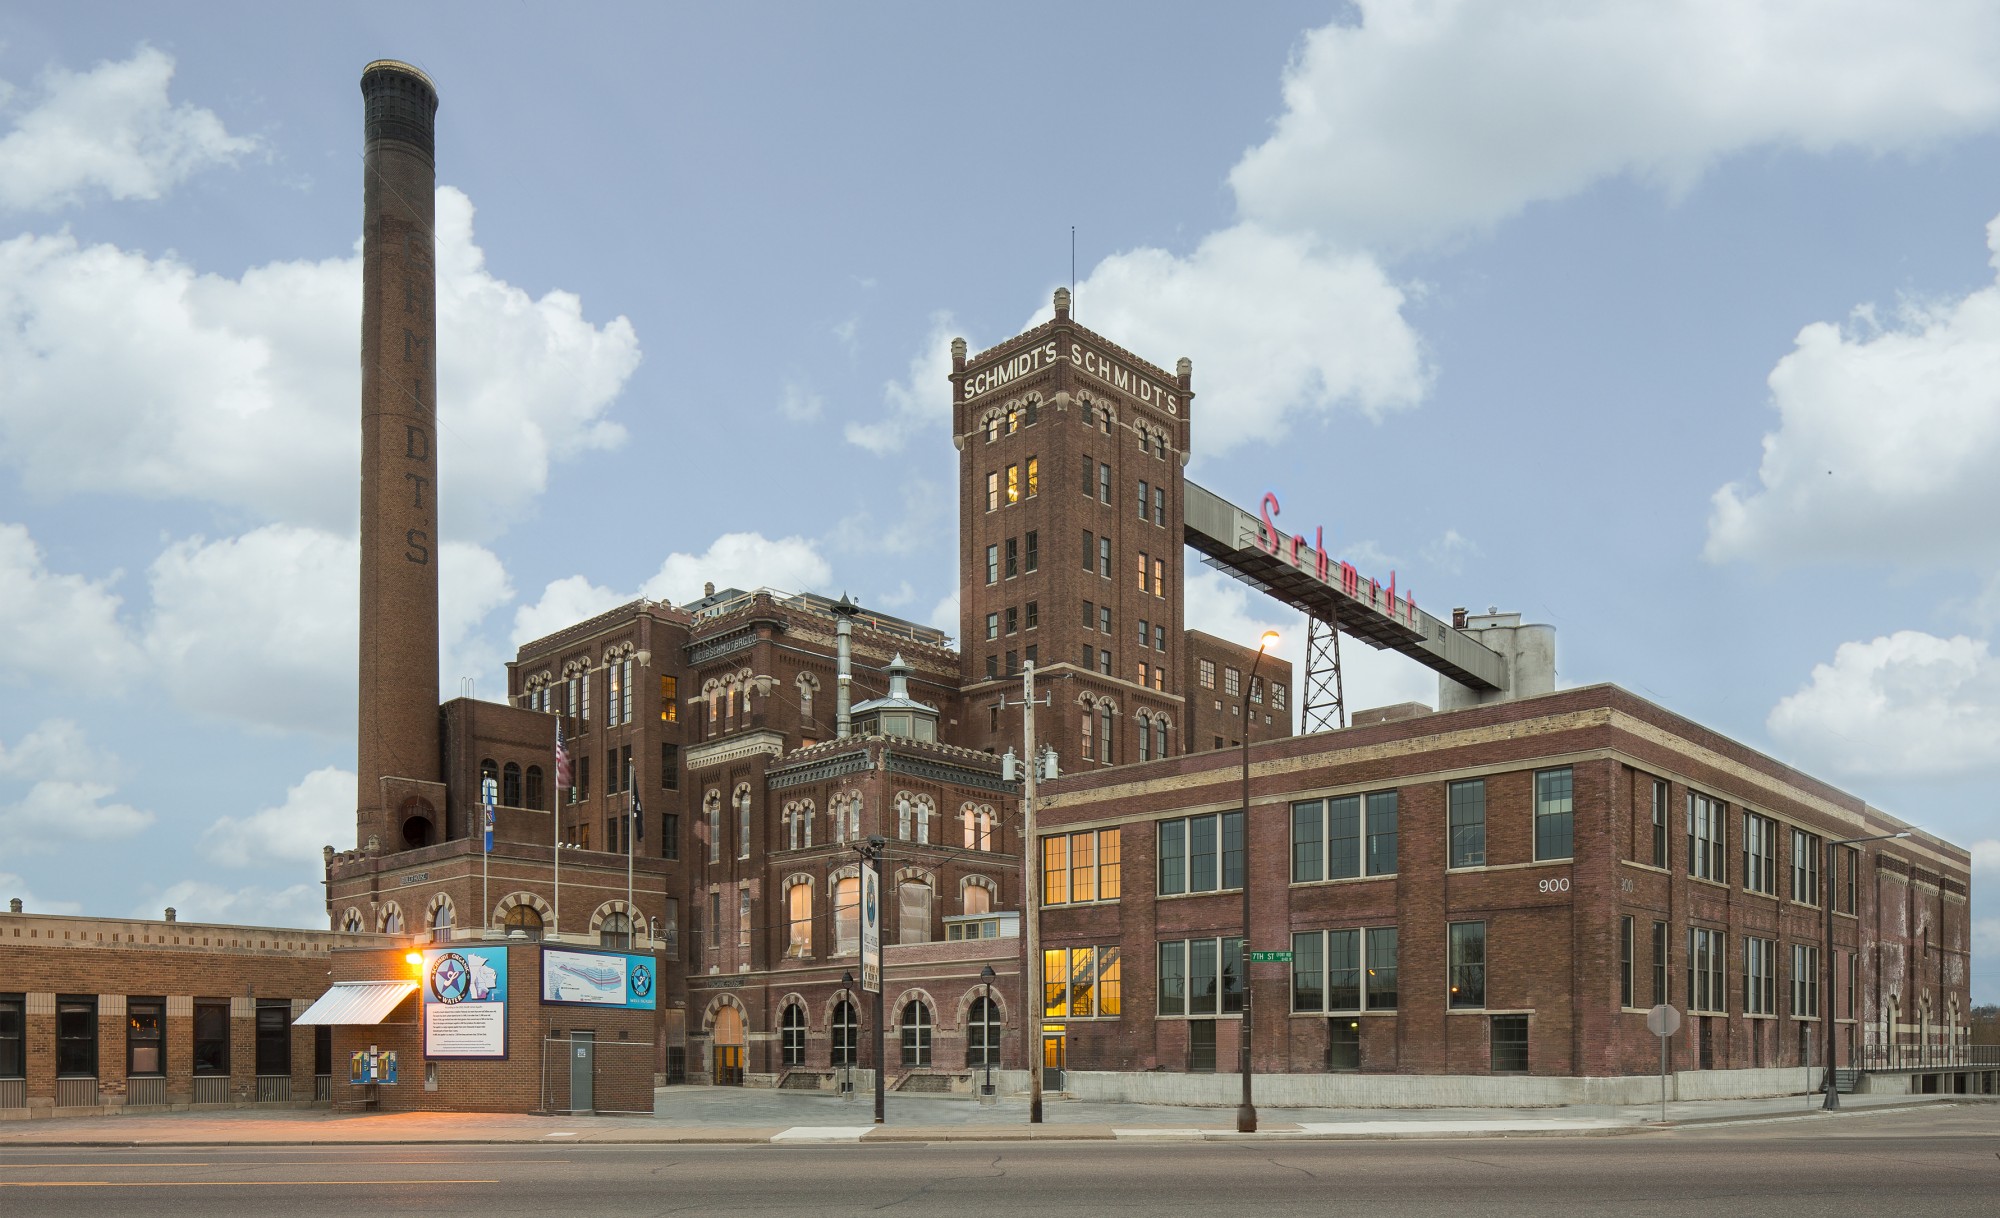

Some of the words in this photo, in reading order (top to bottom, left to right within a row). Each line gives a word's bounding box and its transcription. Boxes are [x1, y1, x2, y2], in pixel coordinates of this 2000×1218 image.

[964, 341, 1057, 400] SCHMIDT'S
[1071, 343, 1178, 416] SCHMIDT'S
[1539, 877, 1570, 893] 900
[451, 953, 470, 974] ORGANIC
[1252, 952, 1264, 960] 7TH
[1267, 952, 1275, 960] ST
[442, 995, 463, 1005] WATER
